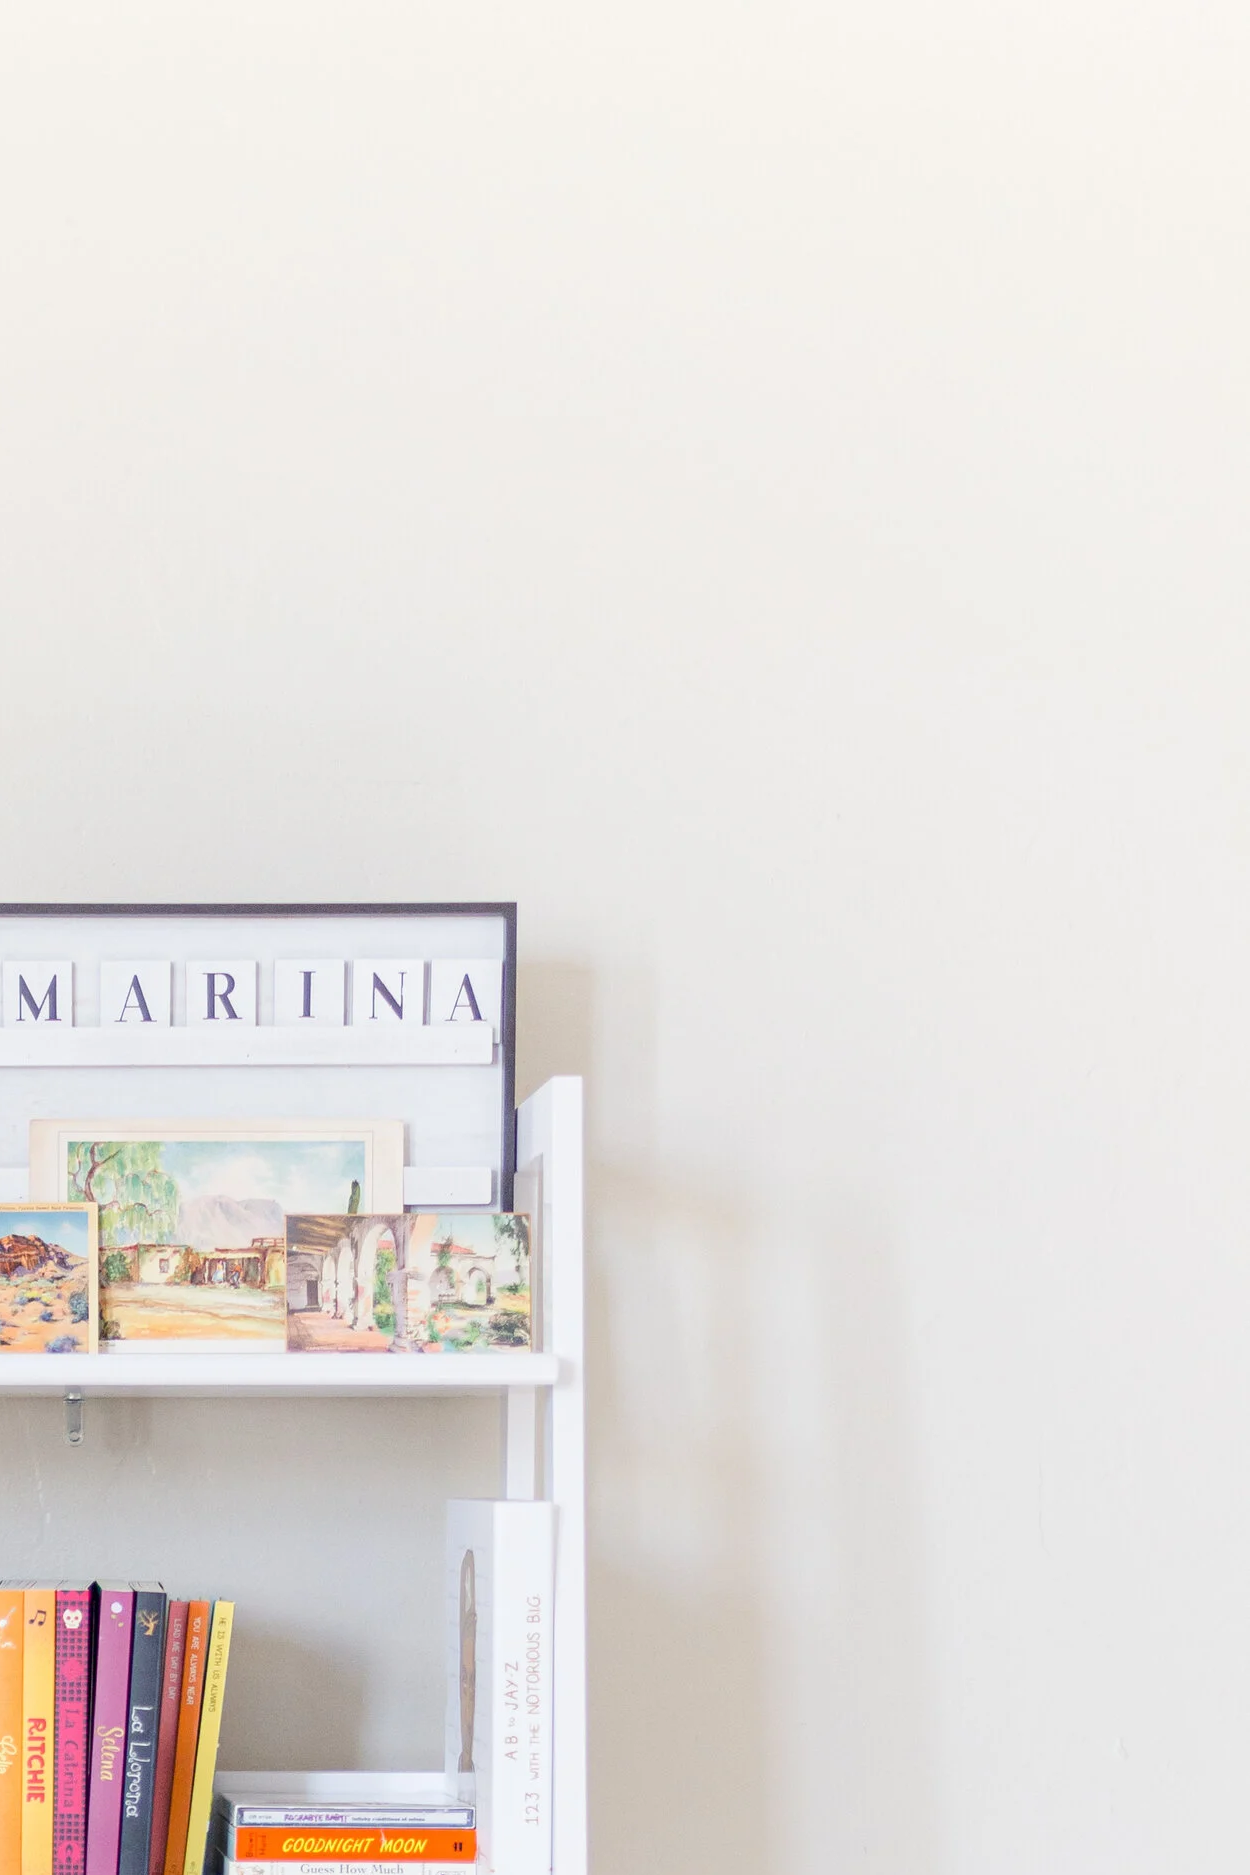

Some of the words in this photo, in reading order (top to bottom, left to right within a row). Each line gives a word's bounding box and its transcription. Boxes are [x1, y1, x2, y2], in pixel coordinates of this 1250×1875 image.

[16, 971, 488, 1023] MARINA
[193, 1616, 202, 1633] YOU
[191, 1636, 199, 1650] ARE
[214, 1644, 224, 1666] WITH
[188, 1653, 198, 1683] ALWAYS
[526, 1631, 540, 1715] NOTORIOUS
[186, 1687, 196, 1705] NEAR
[208, 1684, 218, 1713] ALWAYS
[64, 1708, 80, 1729] La
[131, 1705, 154, 1734] La
[530, 1723, 540, 1746] THE
[26, 1717, 47, 1804] RITCHIE
[96, 1725, 125, 1782] Selena
[529, 1752, 540, 1781] WITH
[63, 1739, 79, 1808] Catrina
[125, 1741, 152, 1818] Llorona
[281, 1837, 375, 1853] GOODNIGHT
[379, 1838, 429, 1853] MOON
[300, 1864, 335, 1874] Guess
[339, 1864, 367, 1874] How
[372, 1864, 404, 1874] Much
